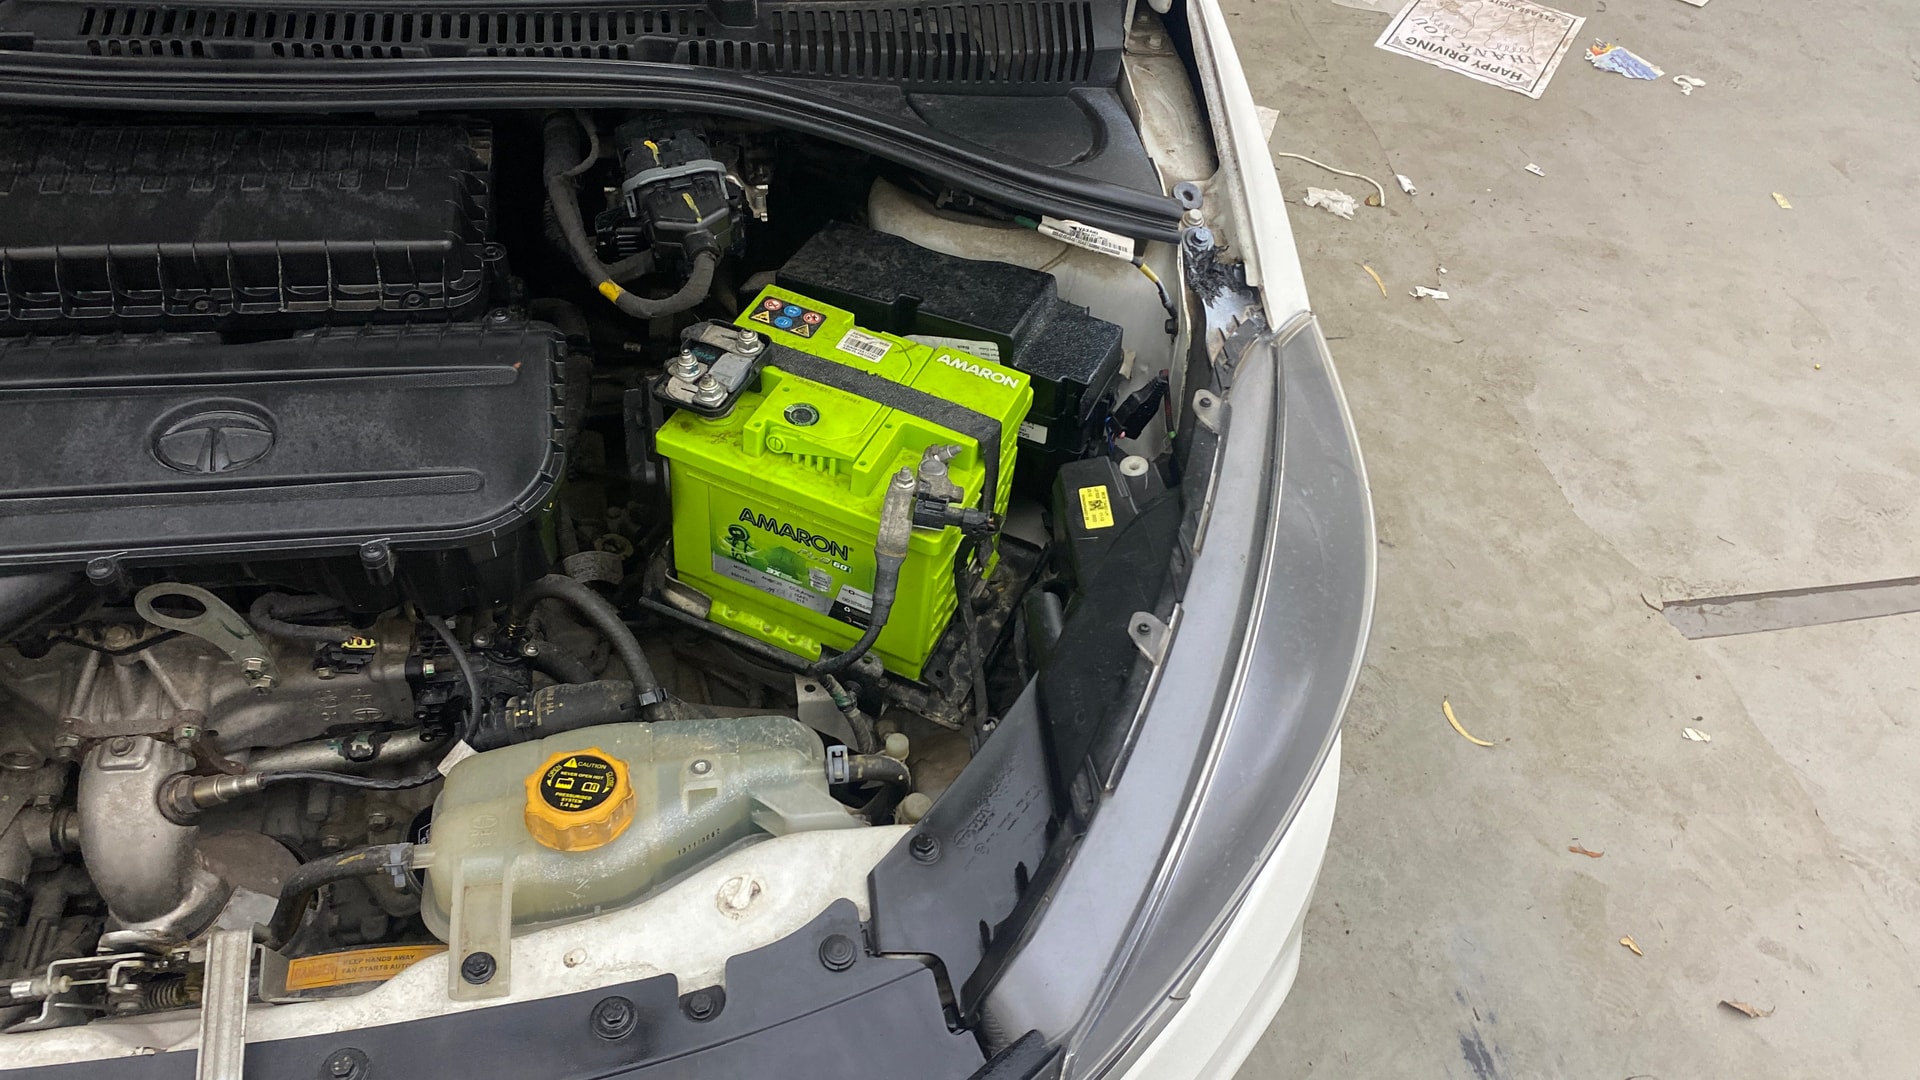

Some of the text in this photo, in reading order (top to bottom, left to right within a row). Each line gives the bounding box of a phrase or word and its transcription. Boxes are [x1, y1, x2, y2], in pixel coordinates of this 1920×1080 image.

[1411, 17, 1541, 65] THANK YOU
[1405, 36, 1522, 81] HAPPY DRIVING
[936, 354, 1020, 389] AMARON
[739, 507, 849, 561] AMARON
[547, 764, 562, 778] OPEN
[577, 761, 607, 769] CAUTION
[358, 964, 388, 973] STARTS
[365, 955, 392, 963] HANDS
